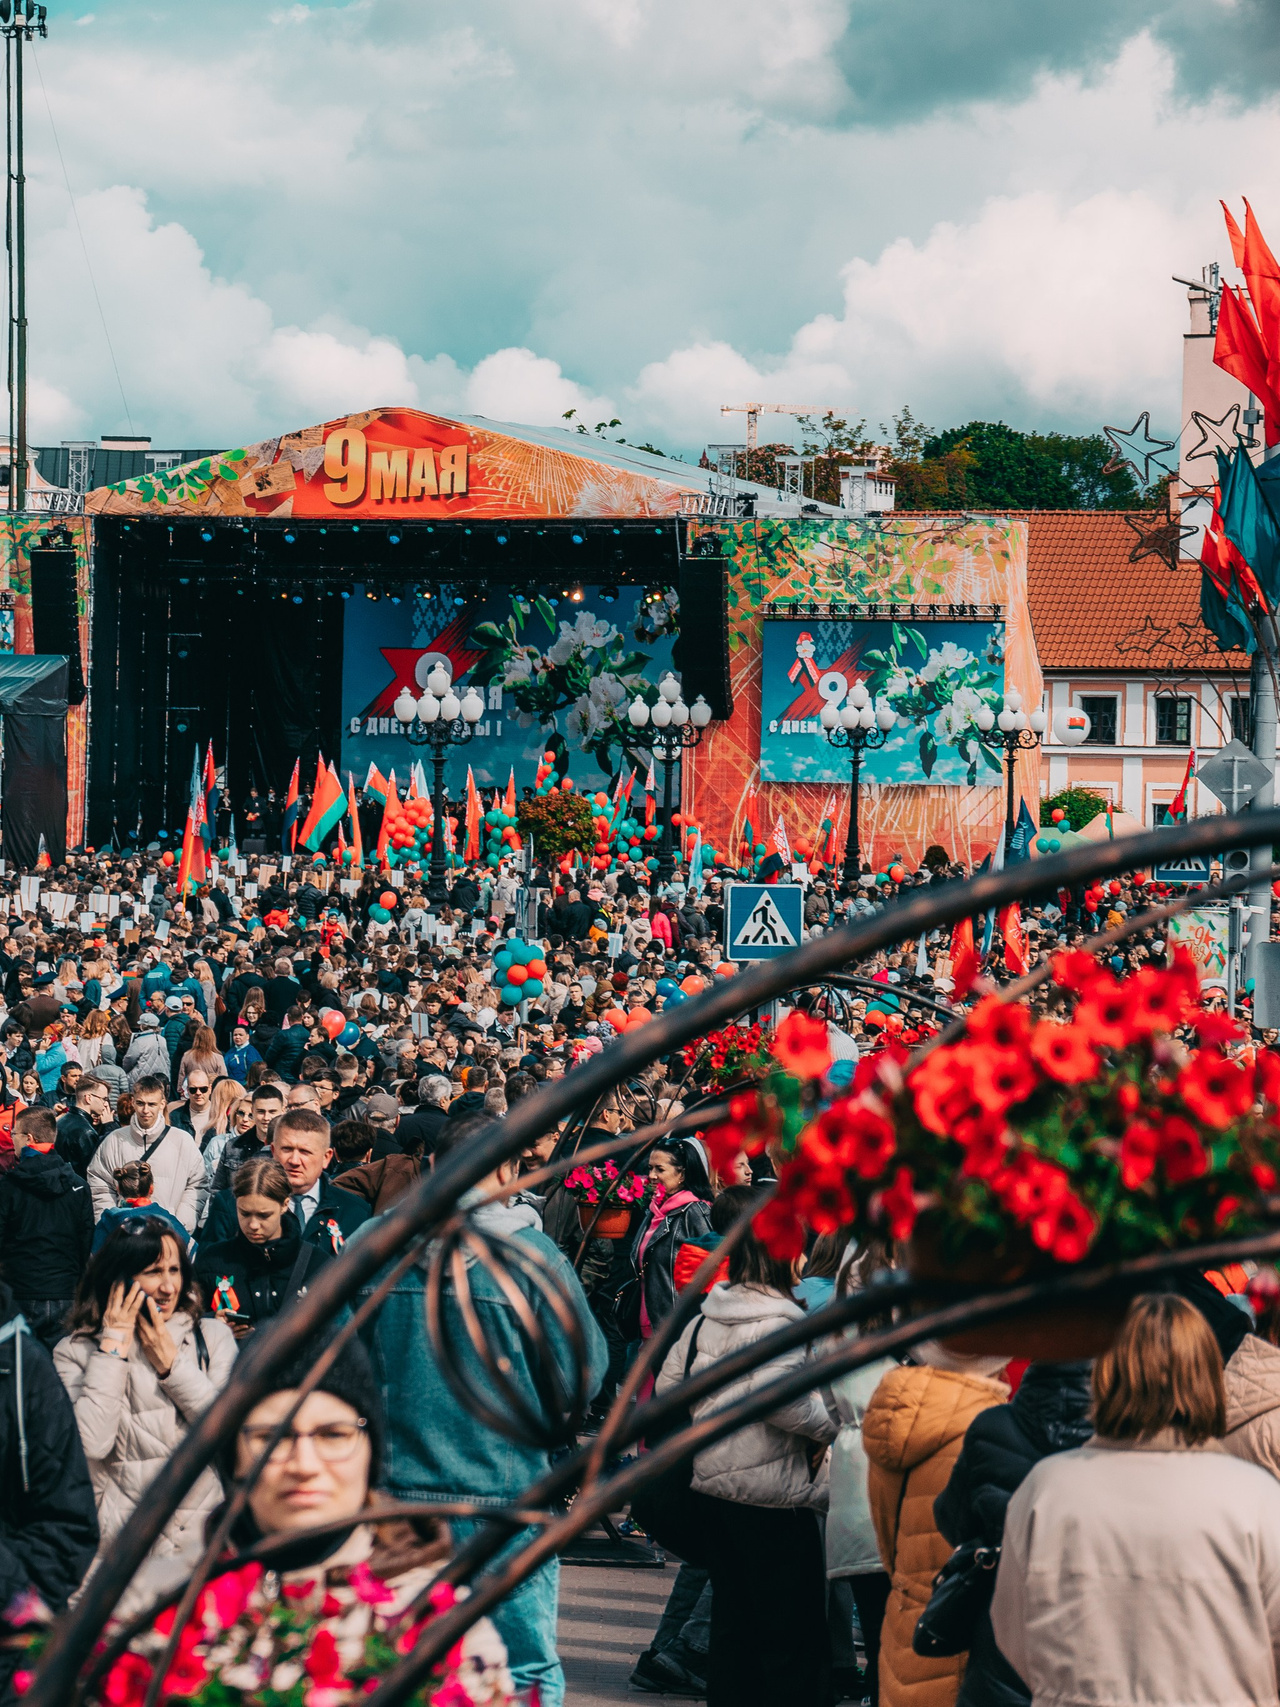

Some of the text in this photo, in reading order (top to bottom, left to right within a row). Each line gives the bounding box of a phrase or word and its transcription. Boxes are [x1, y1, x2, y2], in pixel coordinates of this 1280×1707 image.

[323, 428, 468, 504] 9 МАЯ
[781, 720, 818, 735] ДНЕМ
[1195, 926, 1205, 946] 9
